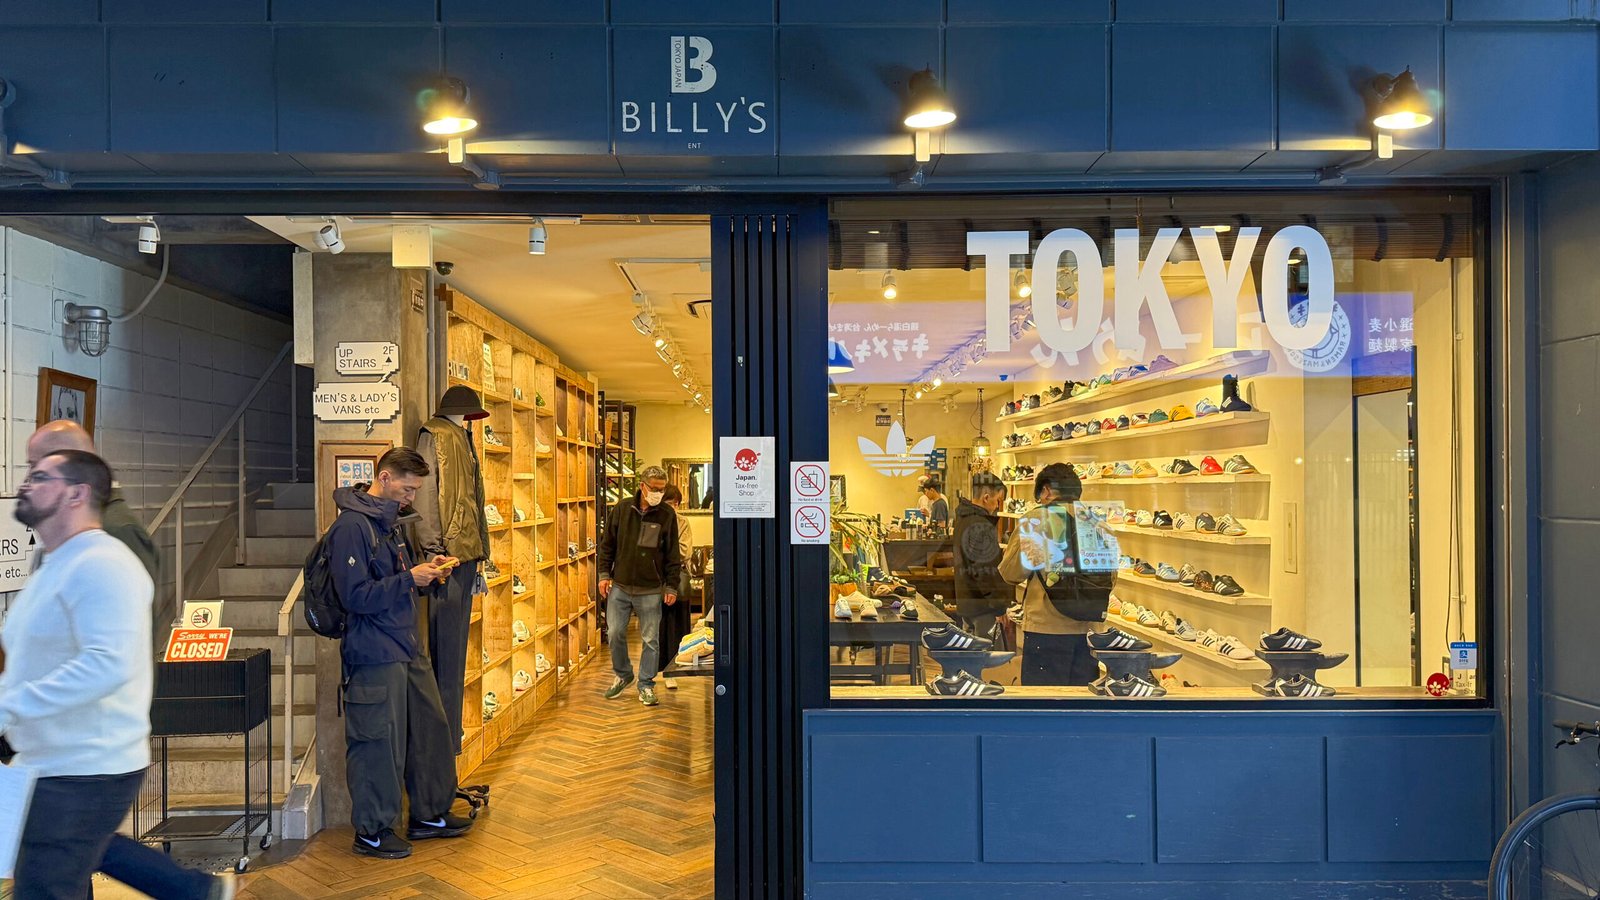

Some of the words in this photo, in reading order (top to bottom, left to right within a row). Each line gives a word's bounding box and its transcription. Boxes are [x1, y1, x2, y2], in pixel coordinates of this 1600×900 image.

[674, 39, 682, 64] TOKYO
[671, 36, 717, 93] B
[674, 65, 682, 88] JAPAN
[622, 97, 767, 133] BILLY'S
[966, 225, 1335, 352] TOKYO
[338, 348, 353, 358] UP
[382, 346, 394, 355] 2F
[339, 359, 377, 368] STAIRS
[315, 392, 347, 403] MEN'S
[350, 394, 357, 402] &
[359, 391, 397, 402] LADY'S
[332, 405, 361, 414] VANS
[364, 406, 380, 414] etc
[735, 482, 759, 490] Tax-free
[738, 489, 755, 497] Shop
[0, 538, 19, 556] RS
[170, 642, 224, 658] CLOSED
